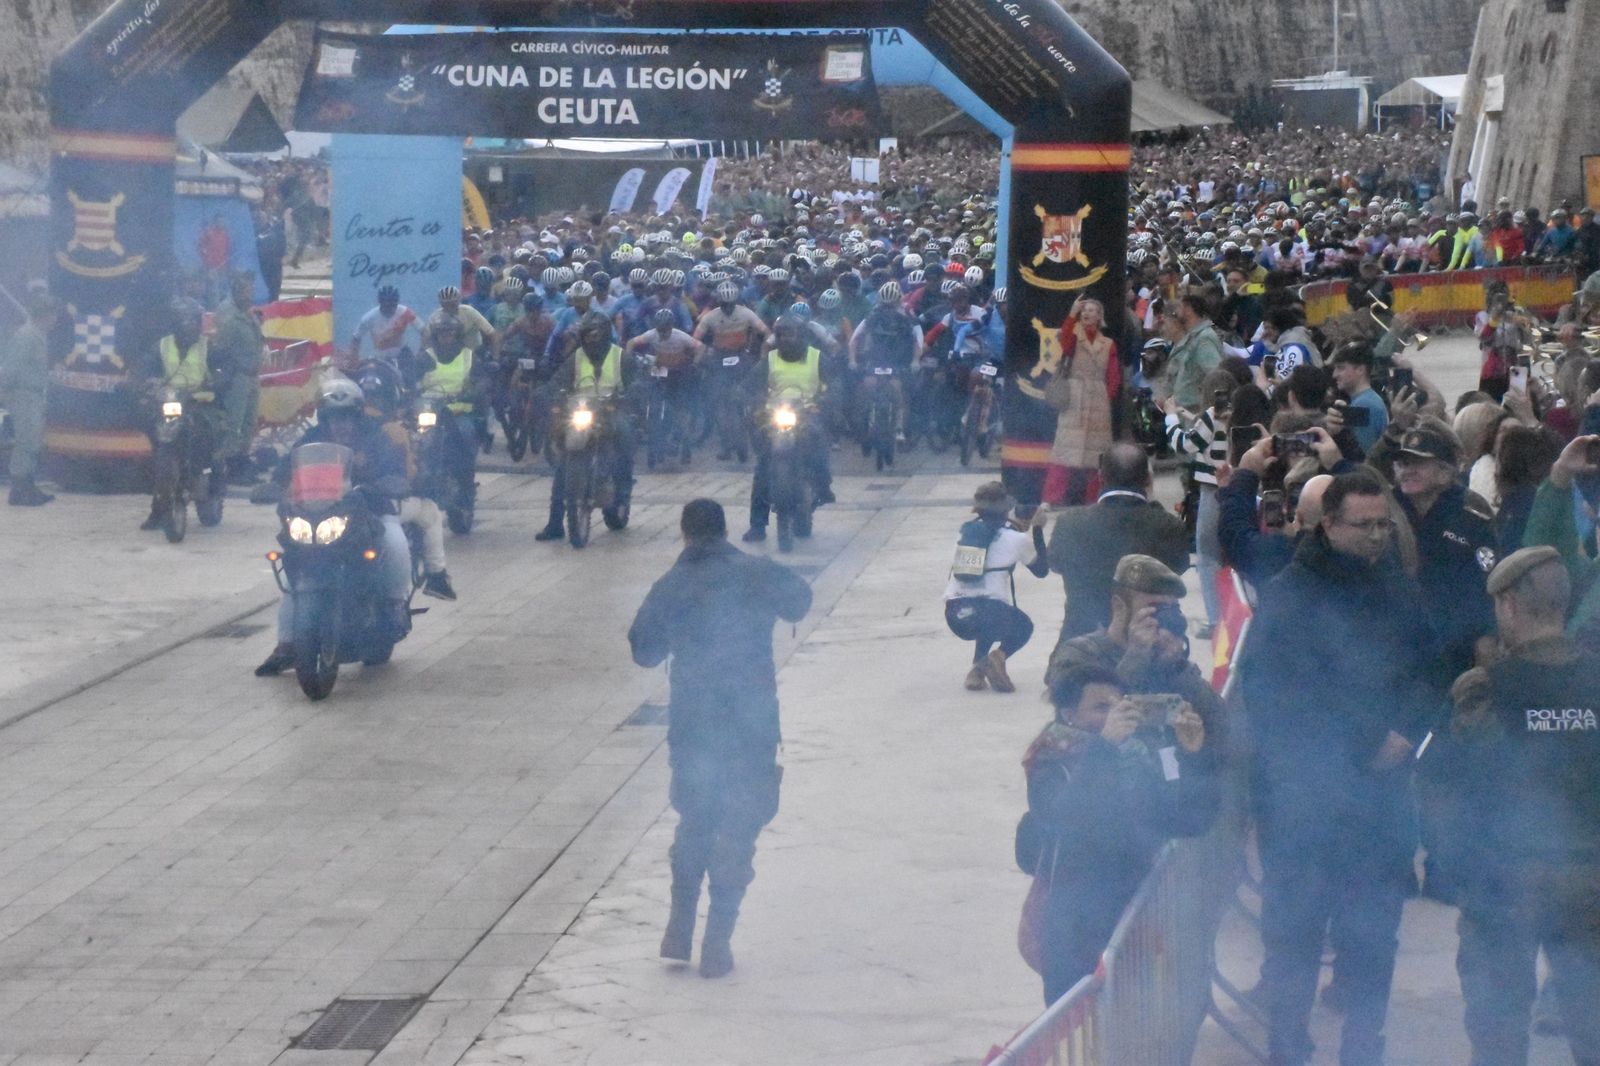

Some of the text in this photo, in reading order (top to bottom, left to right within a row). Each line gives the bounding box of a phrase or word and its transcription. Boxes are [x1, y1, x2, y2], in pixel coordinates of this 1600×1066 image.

[1003, 3, 1020, 16] de
[510, 40, 670, 56] CARRERA CÍVICO-MILITAR
[538, 66, 573, 88] DE
[582, 67, 617, 89] LA
[537, 97, 640, 125] CEUTA
[344, 213, 443, 241] Ceuta es
[348, 253, 445, 288] Deporte
[1525, 708, 1597, 721] POLICIA
[1526, 719, 1599, 732] MILITAR
